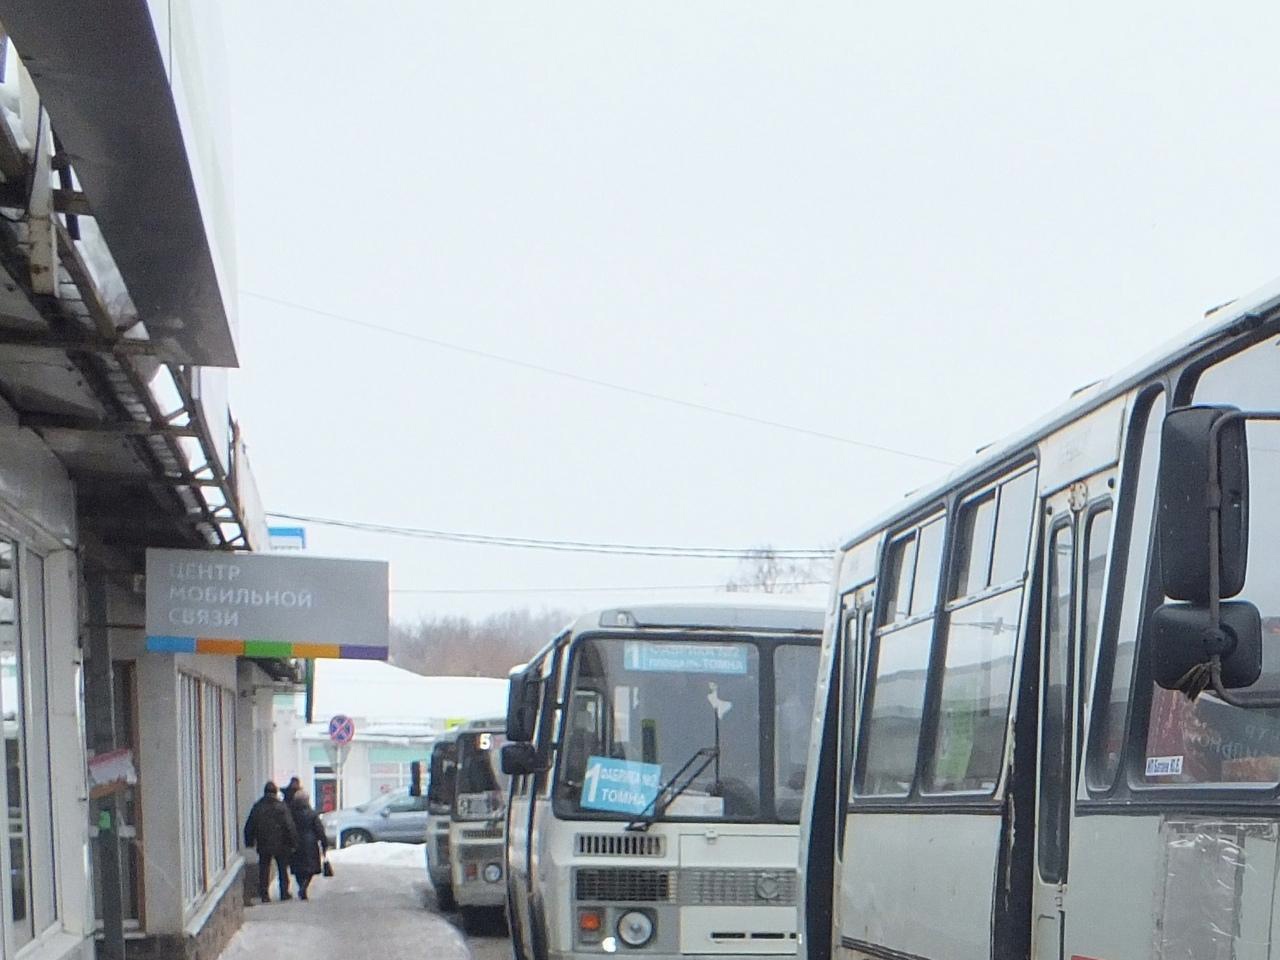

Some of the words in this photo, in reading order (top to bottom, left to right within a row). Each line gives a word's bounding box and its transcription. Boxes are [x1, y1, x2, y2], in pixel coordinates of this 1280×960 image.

[170, 562, 241, 580] ЦЕНТР
[169, 584, 313, 608] МОБИЛЬНОЙ
[168, 607, 240, 627] СВЯЗИ
[585, 763, 602, 802] 1
[602, 788, 646, 806] ТОМНА
